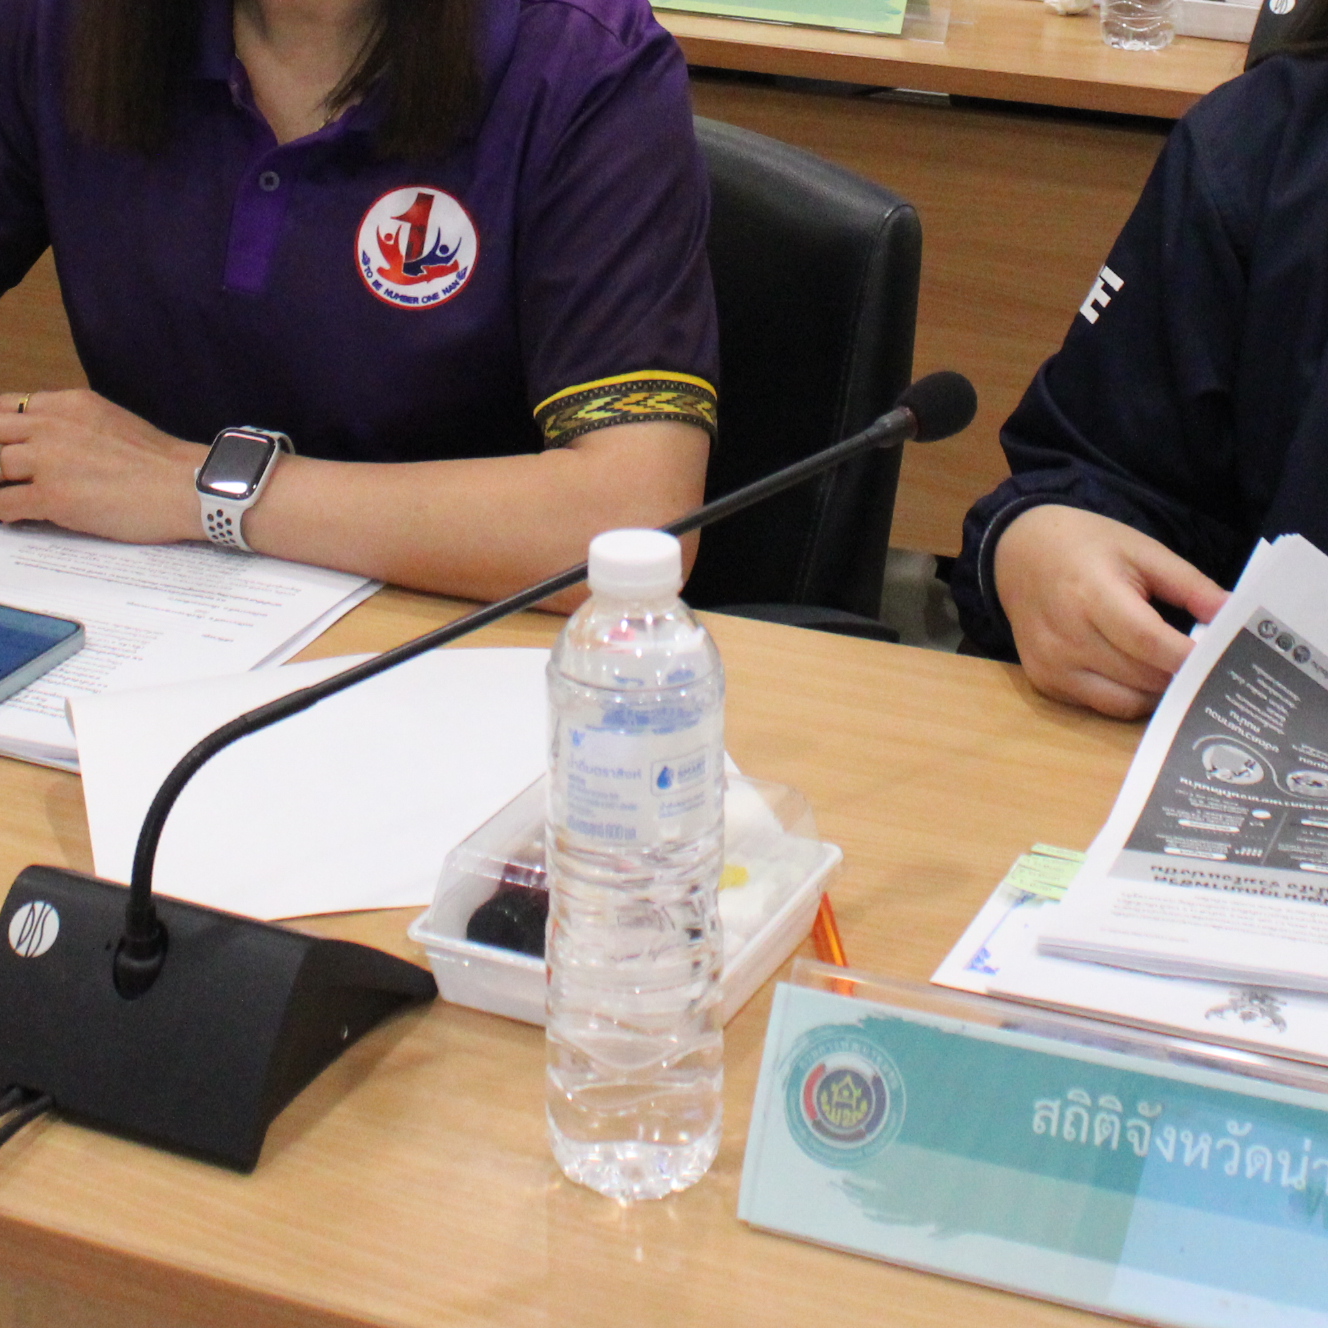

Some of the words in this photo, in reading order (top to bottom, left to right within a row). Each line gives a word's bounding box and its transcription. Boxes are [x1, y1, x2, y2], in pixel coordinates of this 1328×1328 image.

[363, 265, 374, 279] TO
[372, 279, 384, 291] BE
[383, 288, 420, 305] NUMBER
[421, 292, 441, 304] ONE
[441, 279, 461, 297] NAN
